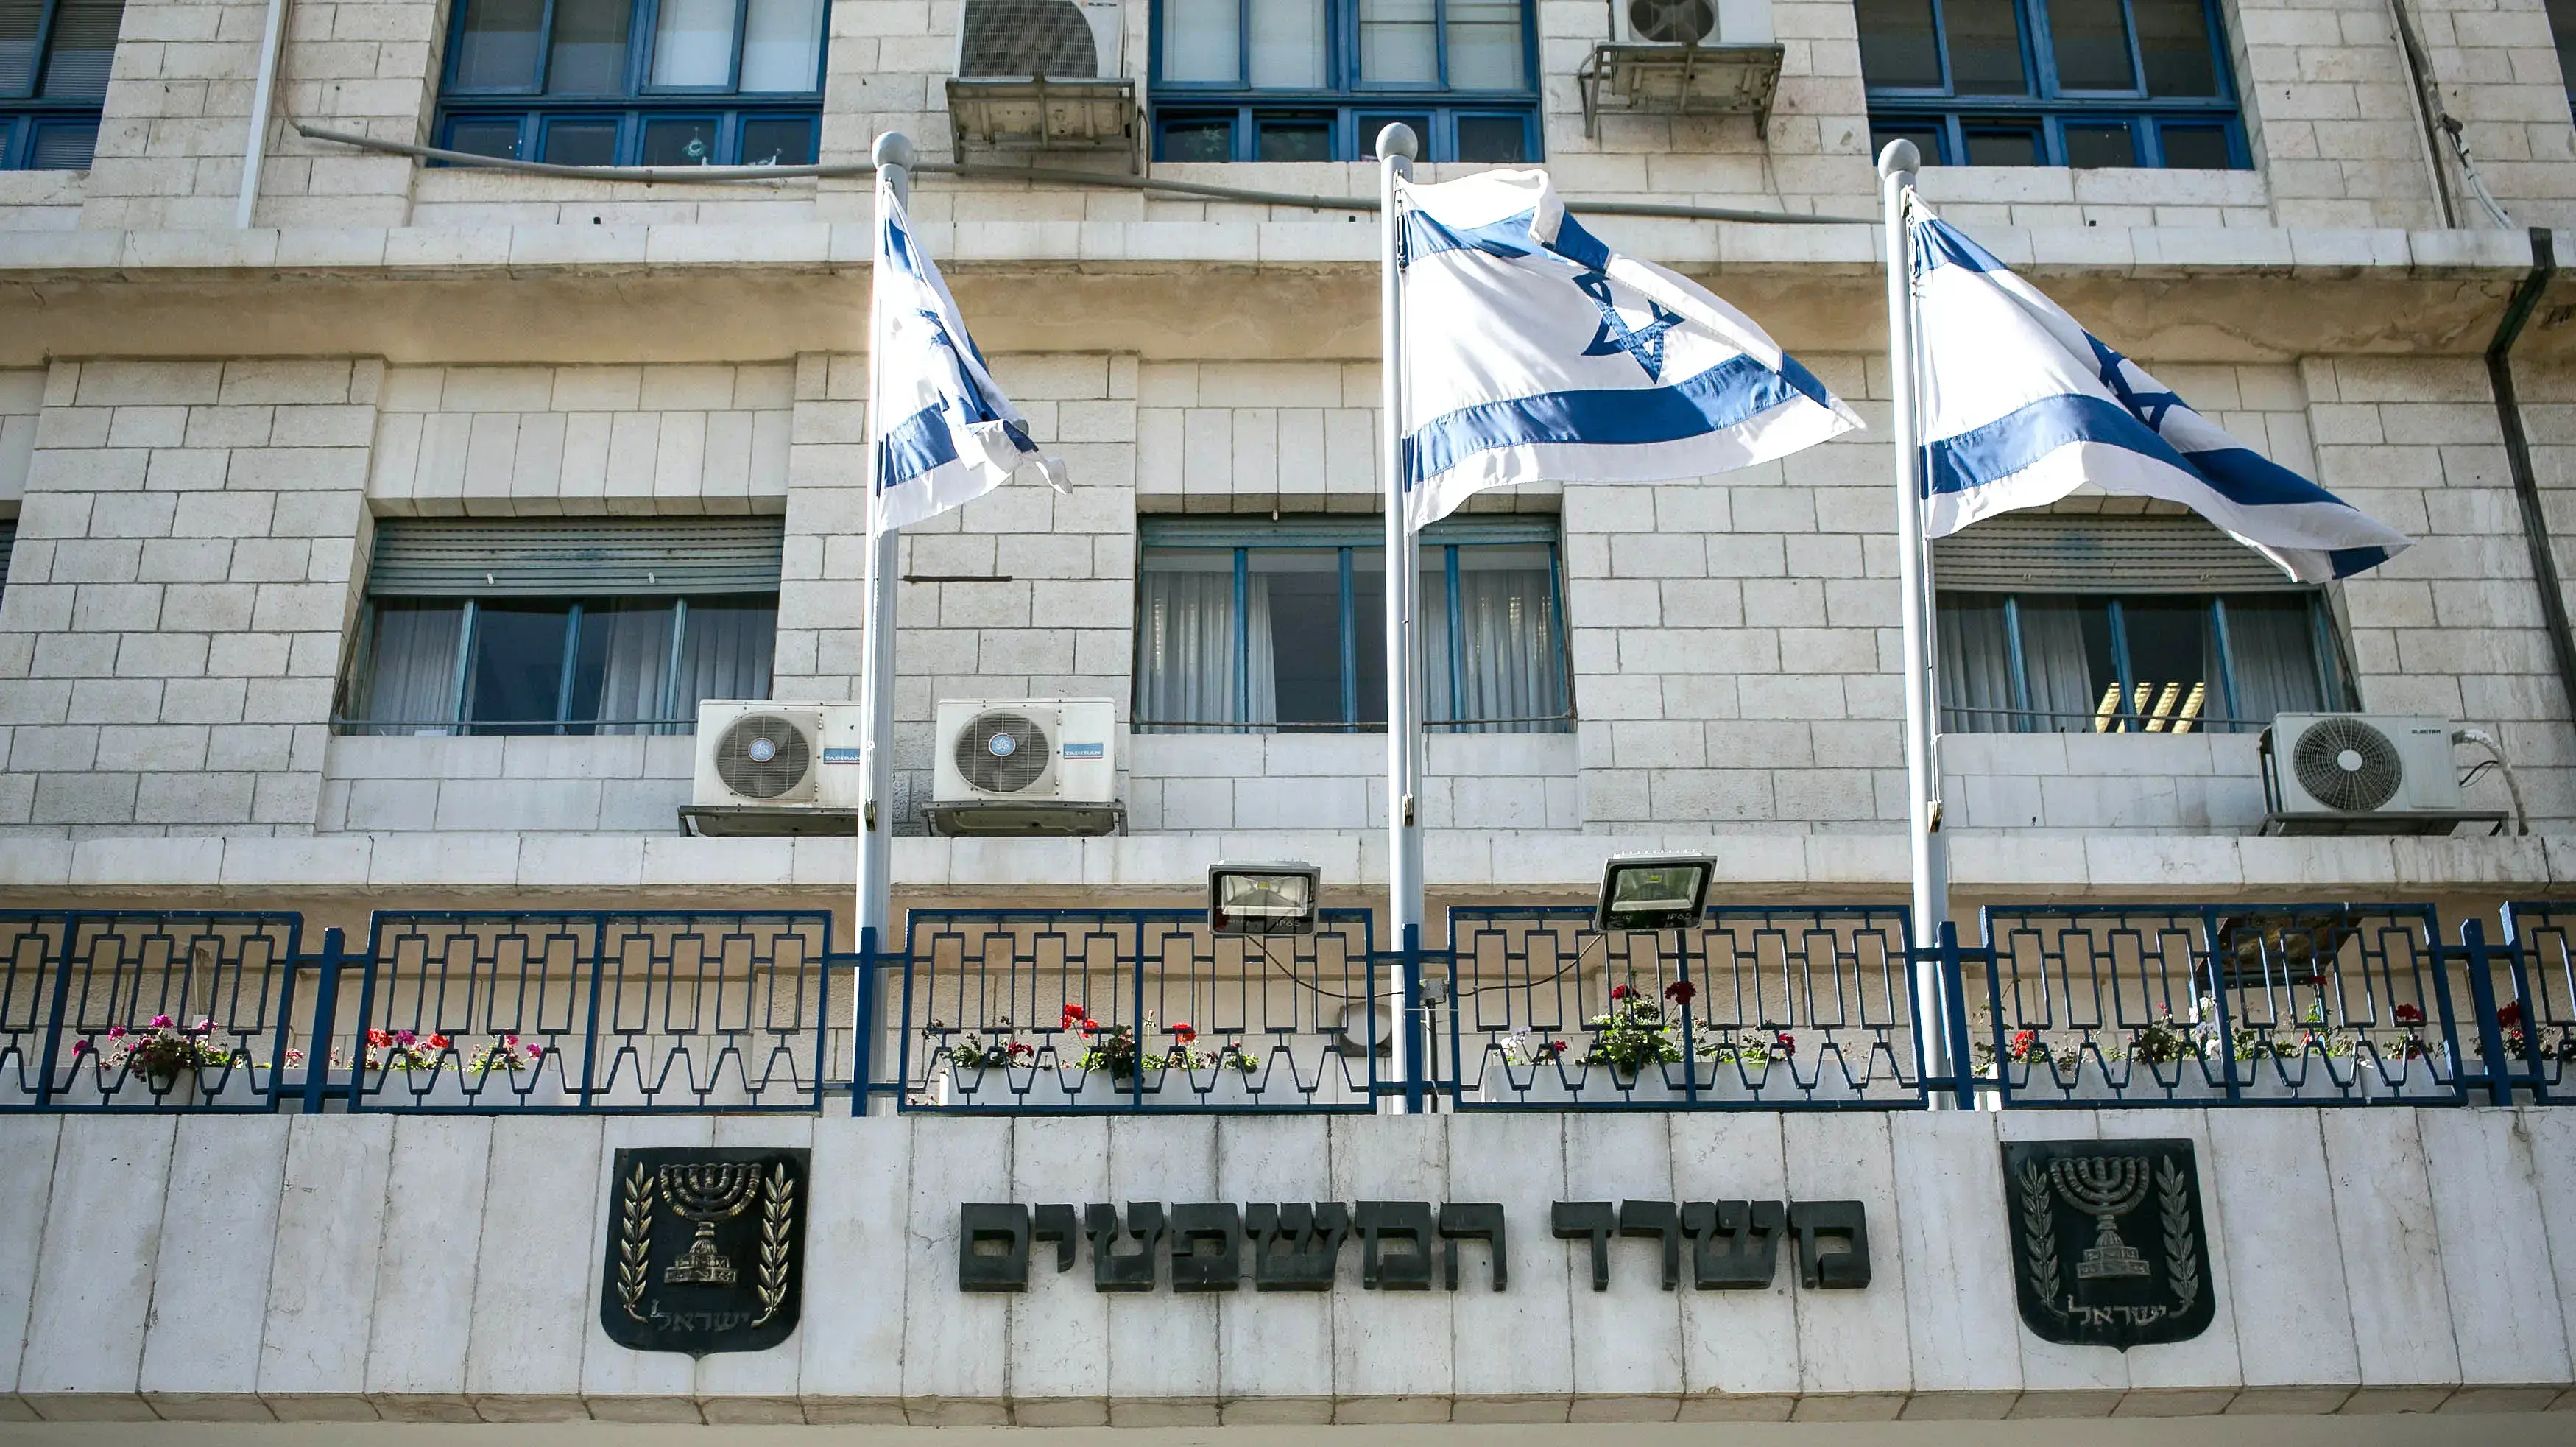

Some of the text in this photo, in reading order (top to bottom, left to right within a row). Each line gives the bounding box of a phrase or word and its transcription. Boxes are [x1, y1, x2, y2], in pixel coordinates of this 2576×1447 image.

[1276, 919, 1302, 927] IP65
[959, 1199, 1872, 1292] משרד המשפטים
[649, 1298, 751, 1331] ישראל
[2067, 1293, 2167, 1326] ישראל
